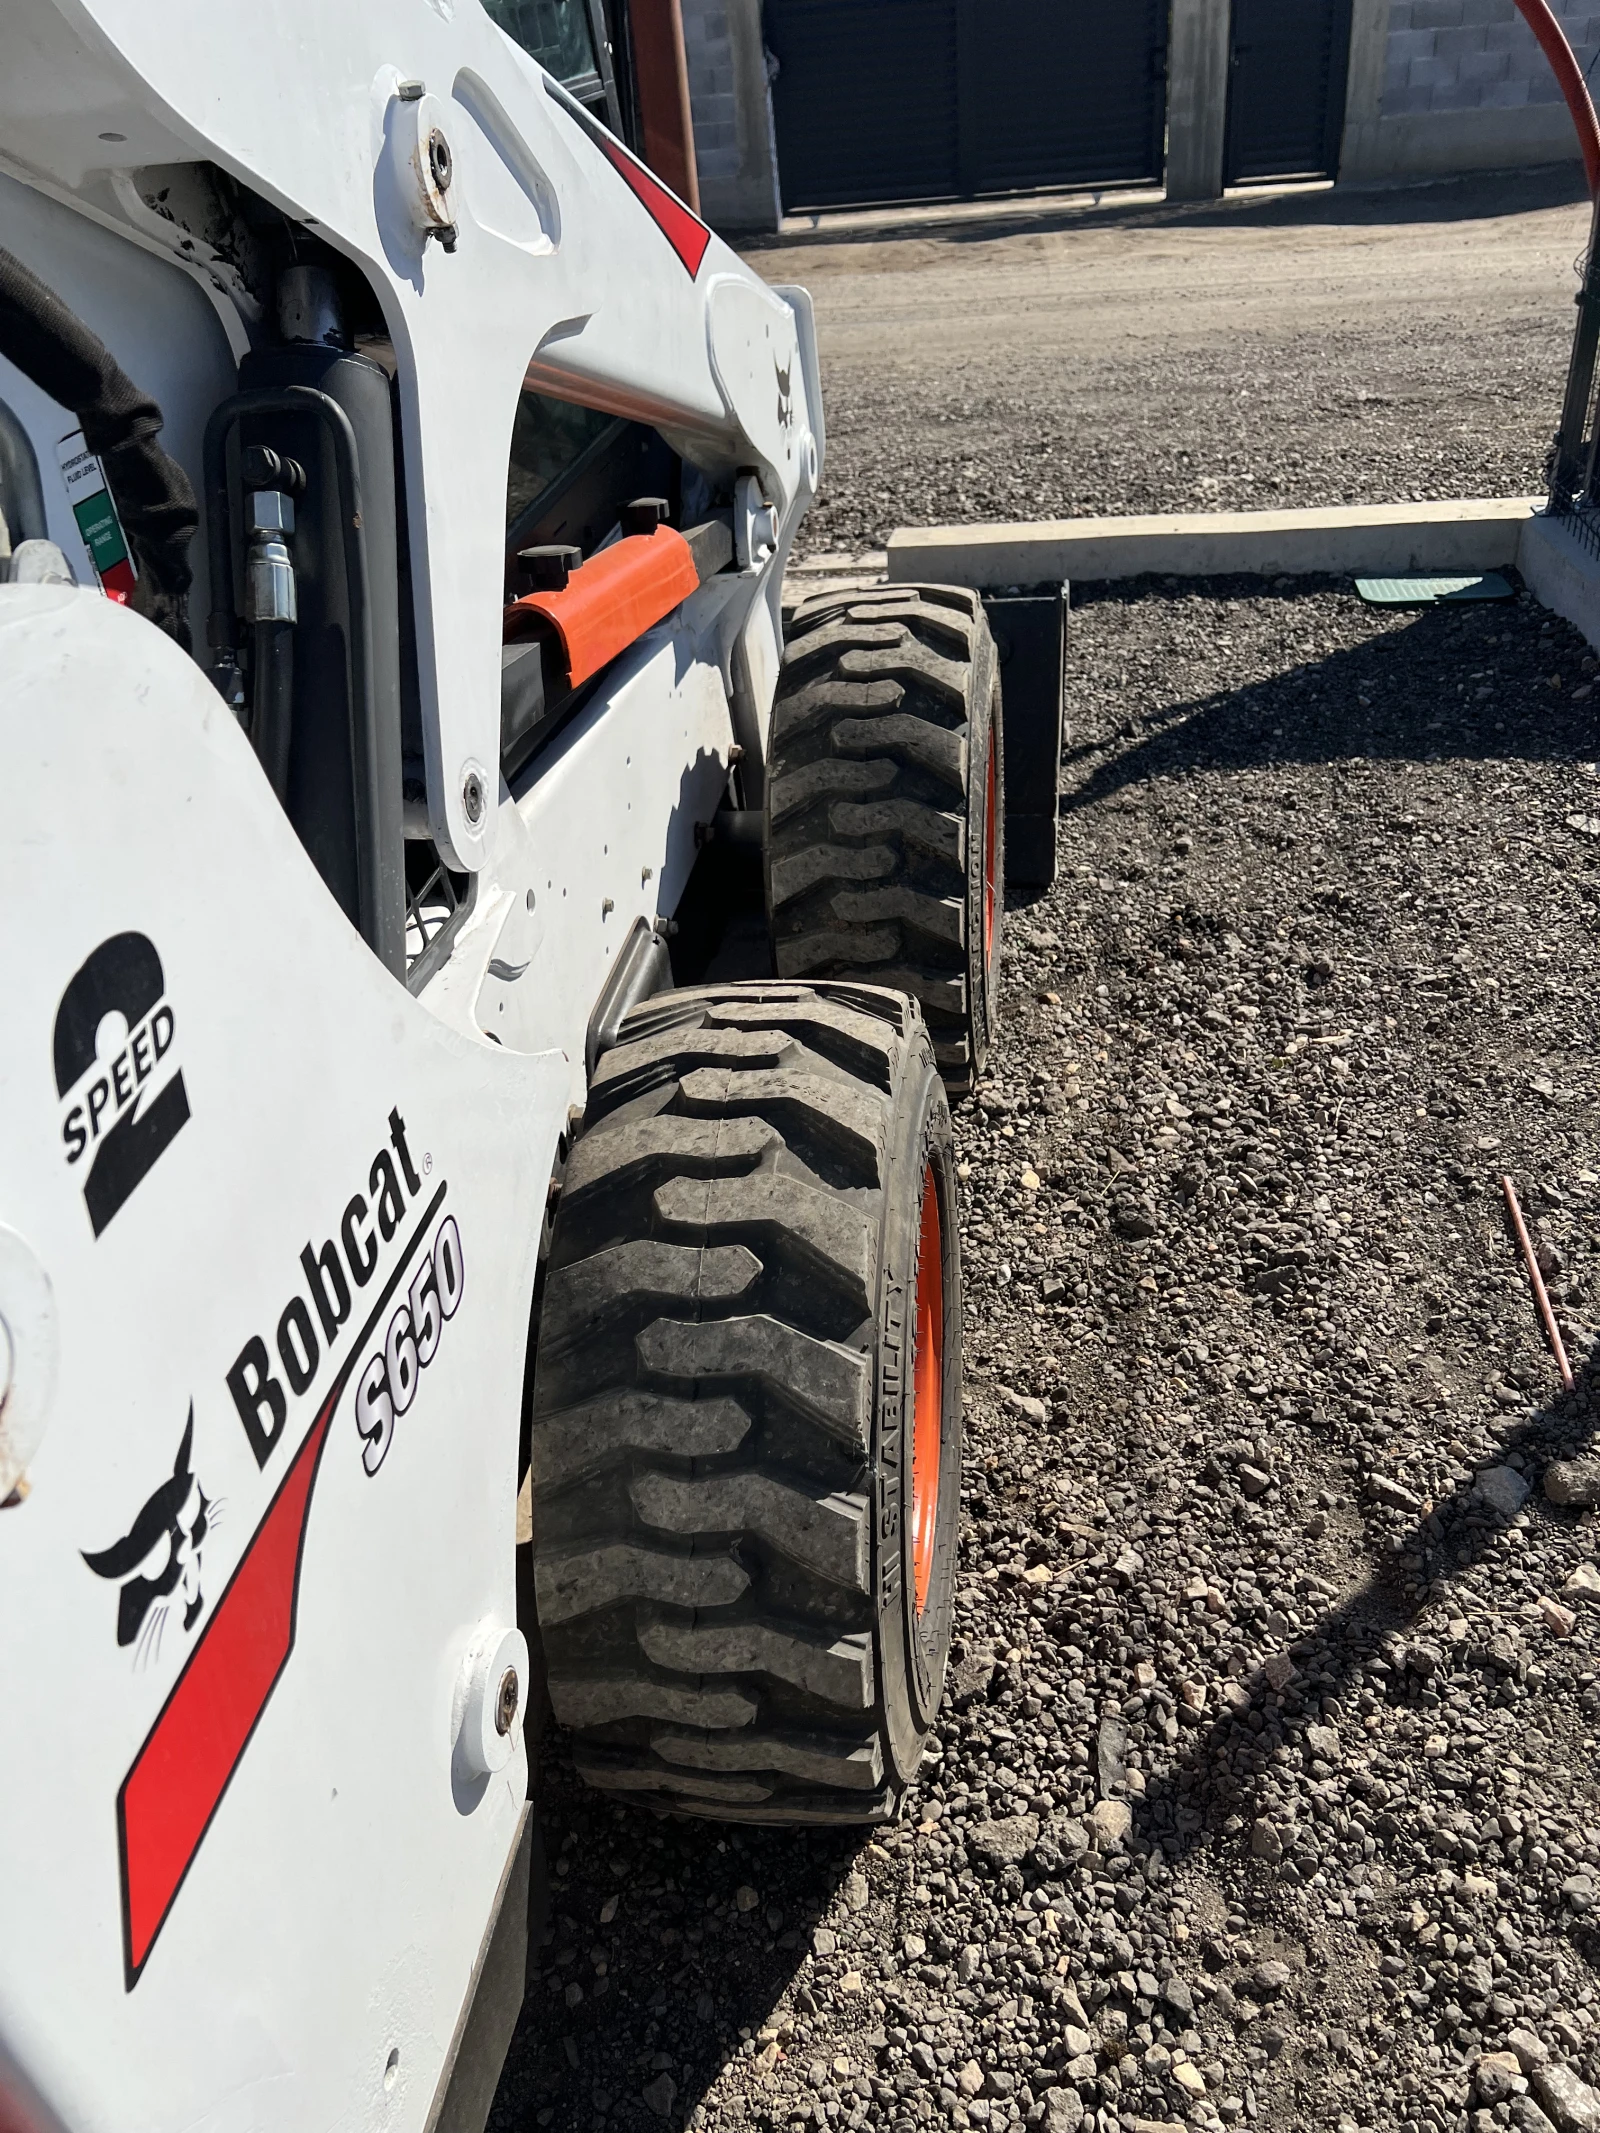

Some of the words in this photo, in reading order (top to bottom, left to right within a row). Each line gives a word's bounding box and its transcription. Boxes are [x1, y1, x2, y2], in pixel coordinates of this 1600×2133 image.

[67, 470, 82, 484] FLUID
[81, 462, 97, 476] LEVEL
[85, 515, 113, 537] OPERATING
[94, 530, 113, 547] RANGE
[970, 833, 983, 994] TRACTION
[62, 1005, 176, 1165] SPEED
[225, 1104, 422, 1473] Bobcat
[355, 1214, 465, 1478] S650
[881, 1263, 904, 1540] STABILITY
